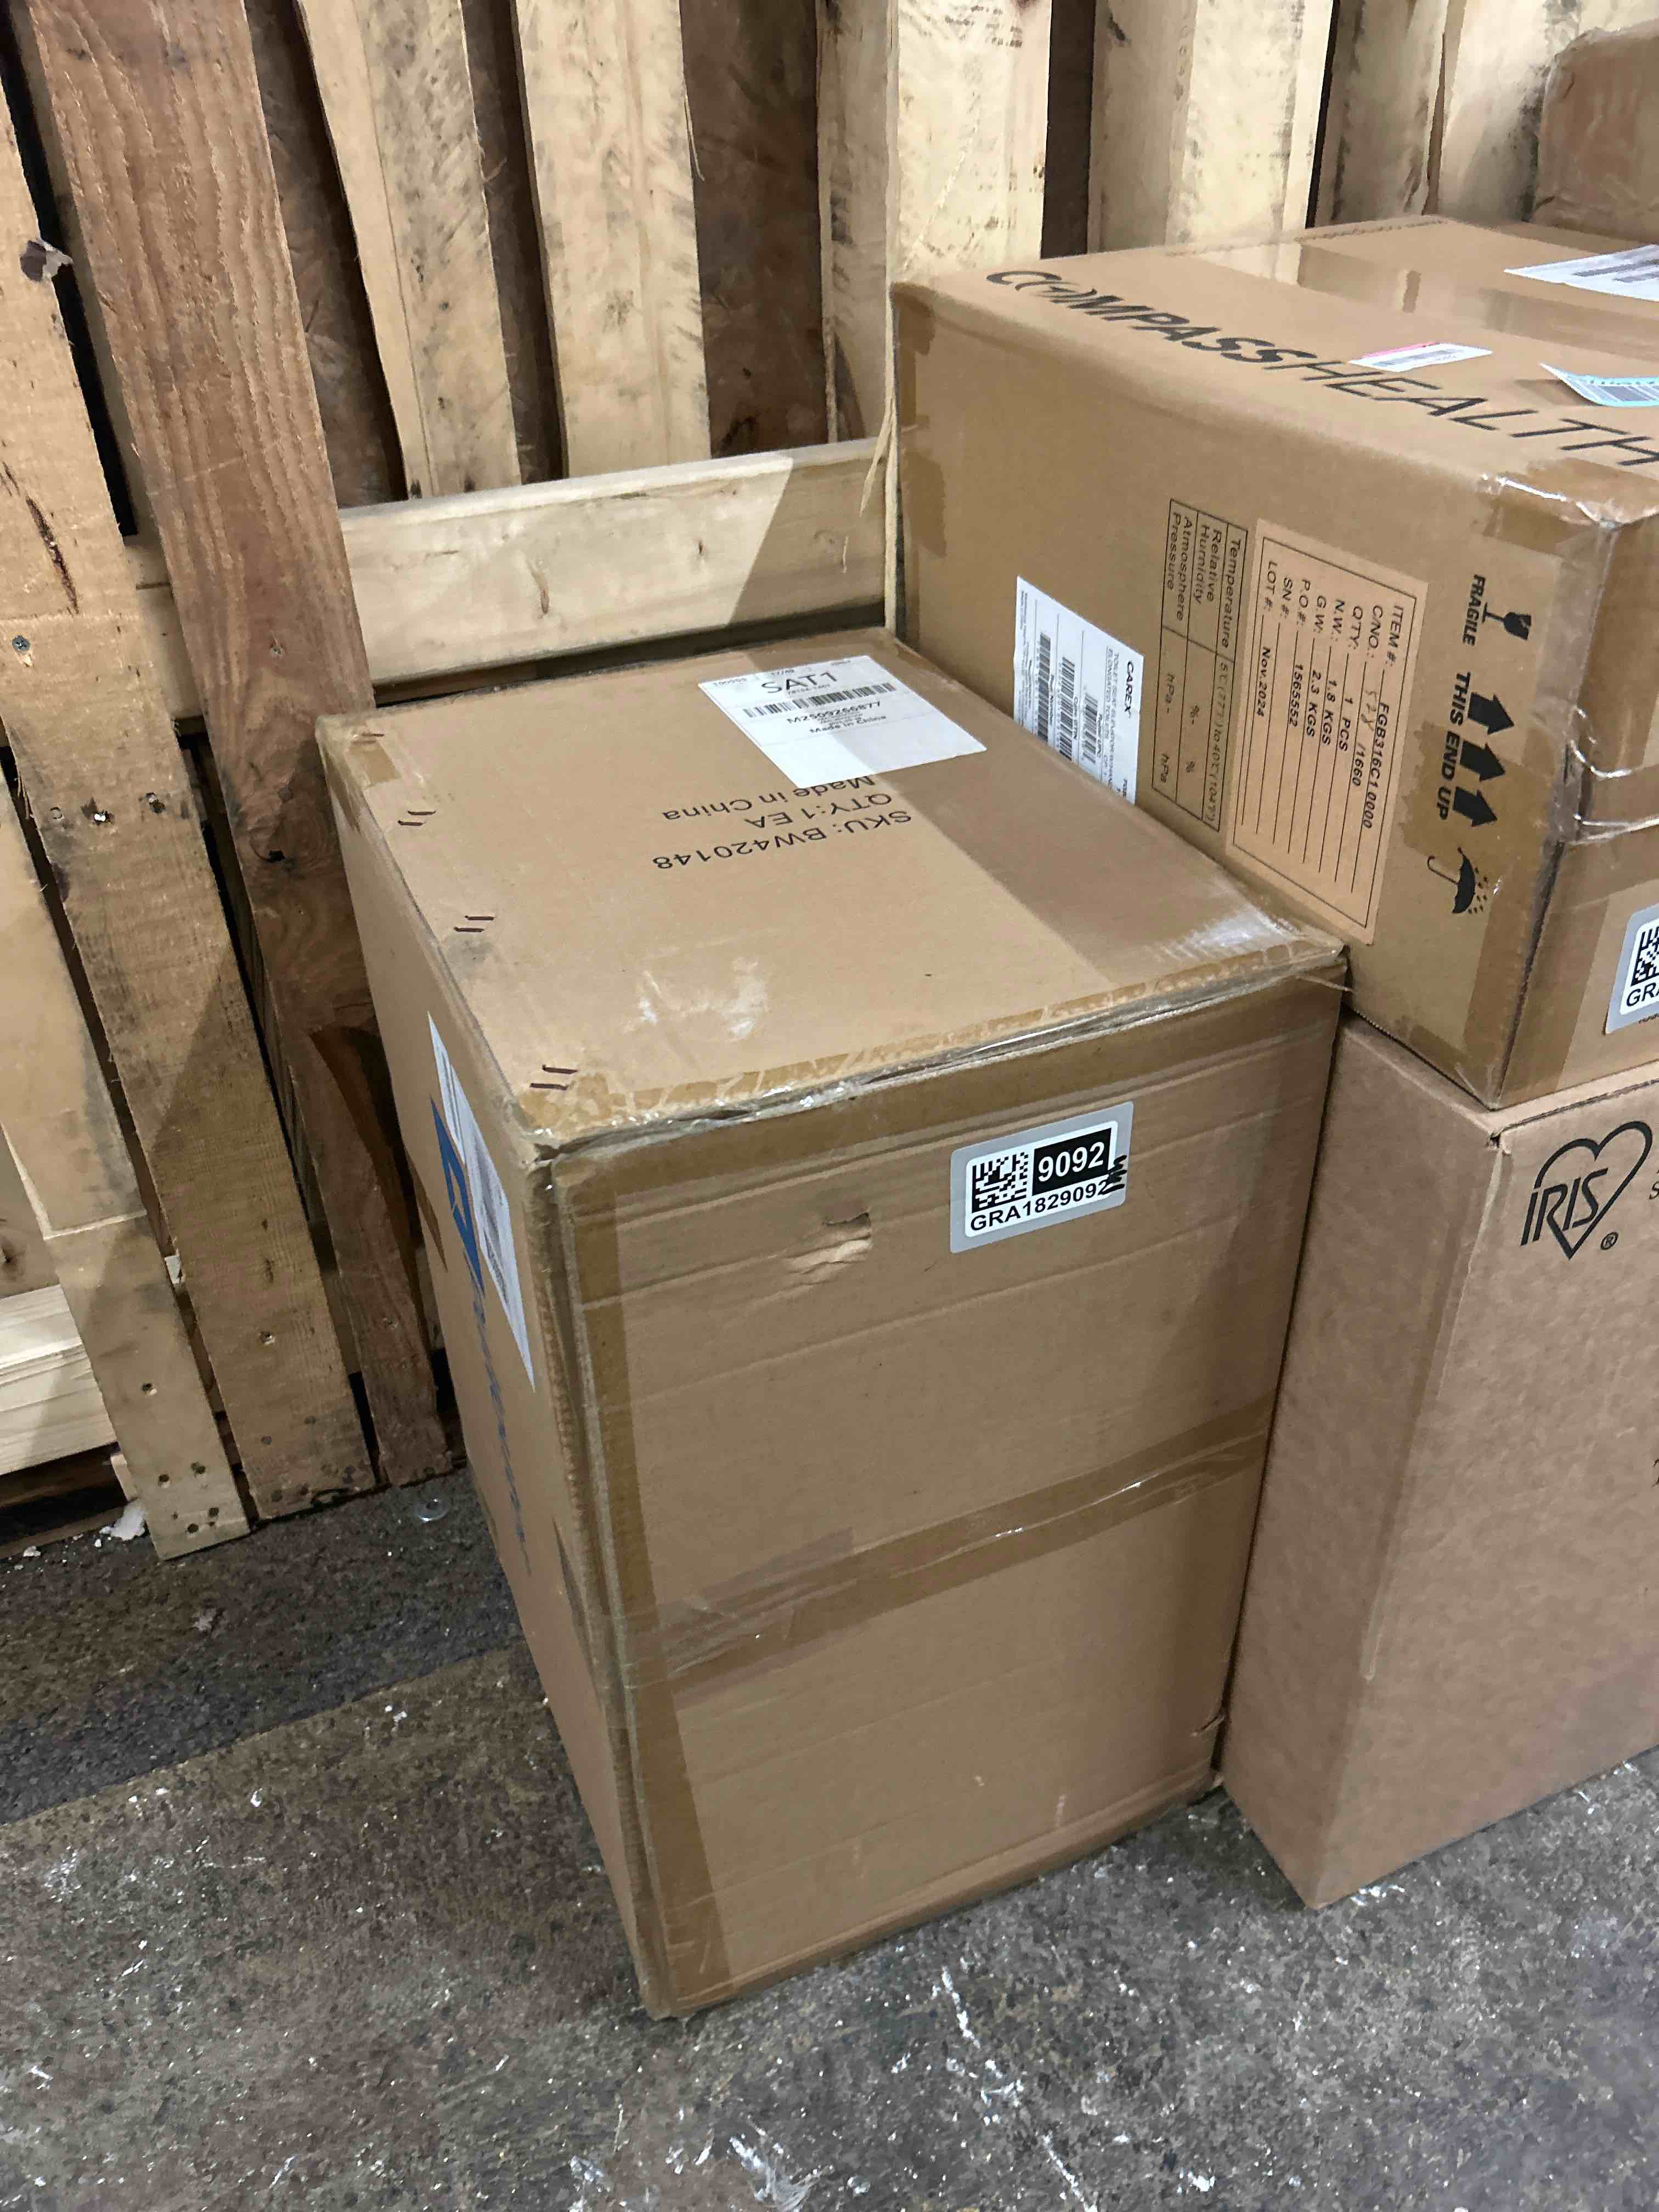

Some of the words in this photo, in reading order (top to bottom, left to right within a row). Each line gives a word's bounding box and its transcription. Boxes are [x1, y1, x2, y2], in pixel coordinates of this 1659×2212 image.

[1167, 511, 1181, 591] Pressure
[1176, 516, 1192, 622] Atmosphere
[1194, 524, 1210, 605] Humidity
[1206, 528, 1222, 602] Relative
[1222, 538, 1242, 649] Temperature
[1266, 560, 1278, 595] LOT
[1282, 577, 1293, 601] SN
[1387, 605, 1404, 648] ITEM
[1462, 574, 1486, 646] FRAGILE
[761, 671, 837, 693] SAT1
[1125, 661, 1133, 713] CAREX
[1257, 646, 1271, 717] Nov.2024
[1289, 663, 1304, 727] 1565552
[1311, 669, 1322, 695] 2.3
[1326, 679, 1338, 703] 1.8
[1449, 671, 1471, 726] THIS
[809, 725, 840, 733] Made
[856, 715, 887, 724] China
[1306, 702, 1318, 738] KGS
[1322, 709, 1334, 746] KGS
[1339, 716, 1351, 752] PCS
[1441, 730, 1460, 782] END
[759, 792, 789, 804] in
[793, 775, 875, 797] Made
[1436, 786, 1452, 821] UP
[663, 799, 752, 820] China
[746, 811, 793, 828] EA
[833, 810, 911, 834] SKU:
[652, 828, 827, 869] BW420148
[1037, 1141, 1104, 1182] 9092
[970, 1181, 1108, 1231] GRA1829092
[1521, 1167, 1609, 1248] IRIS
